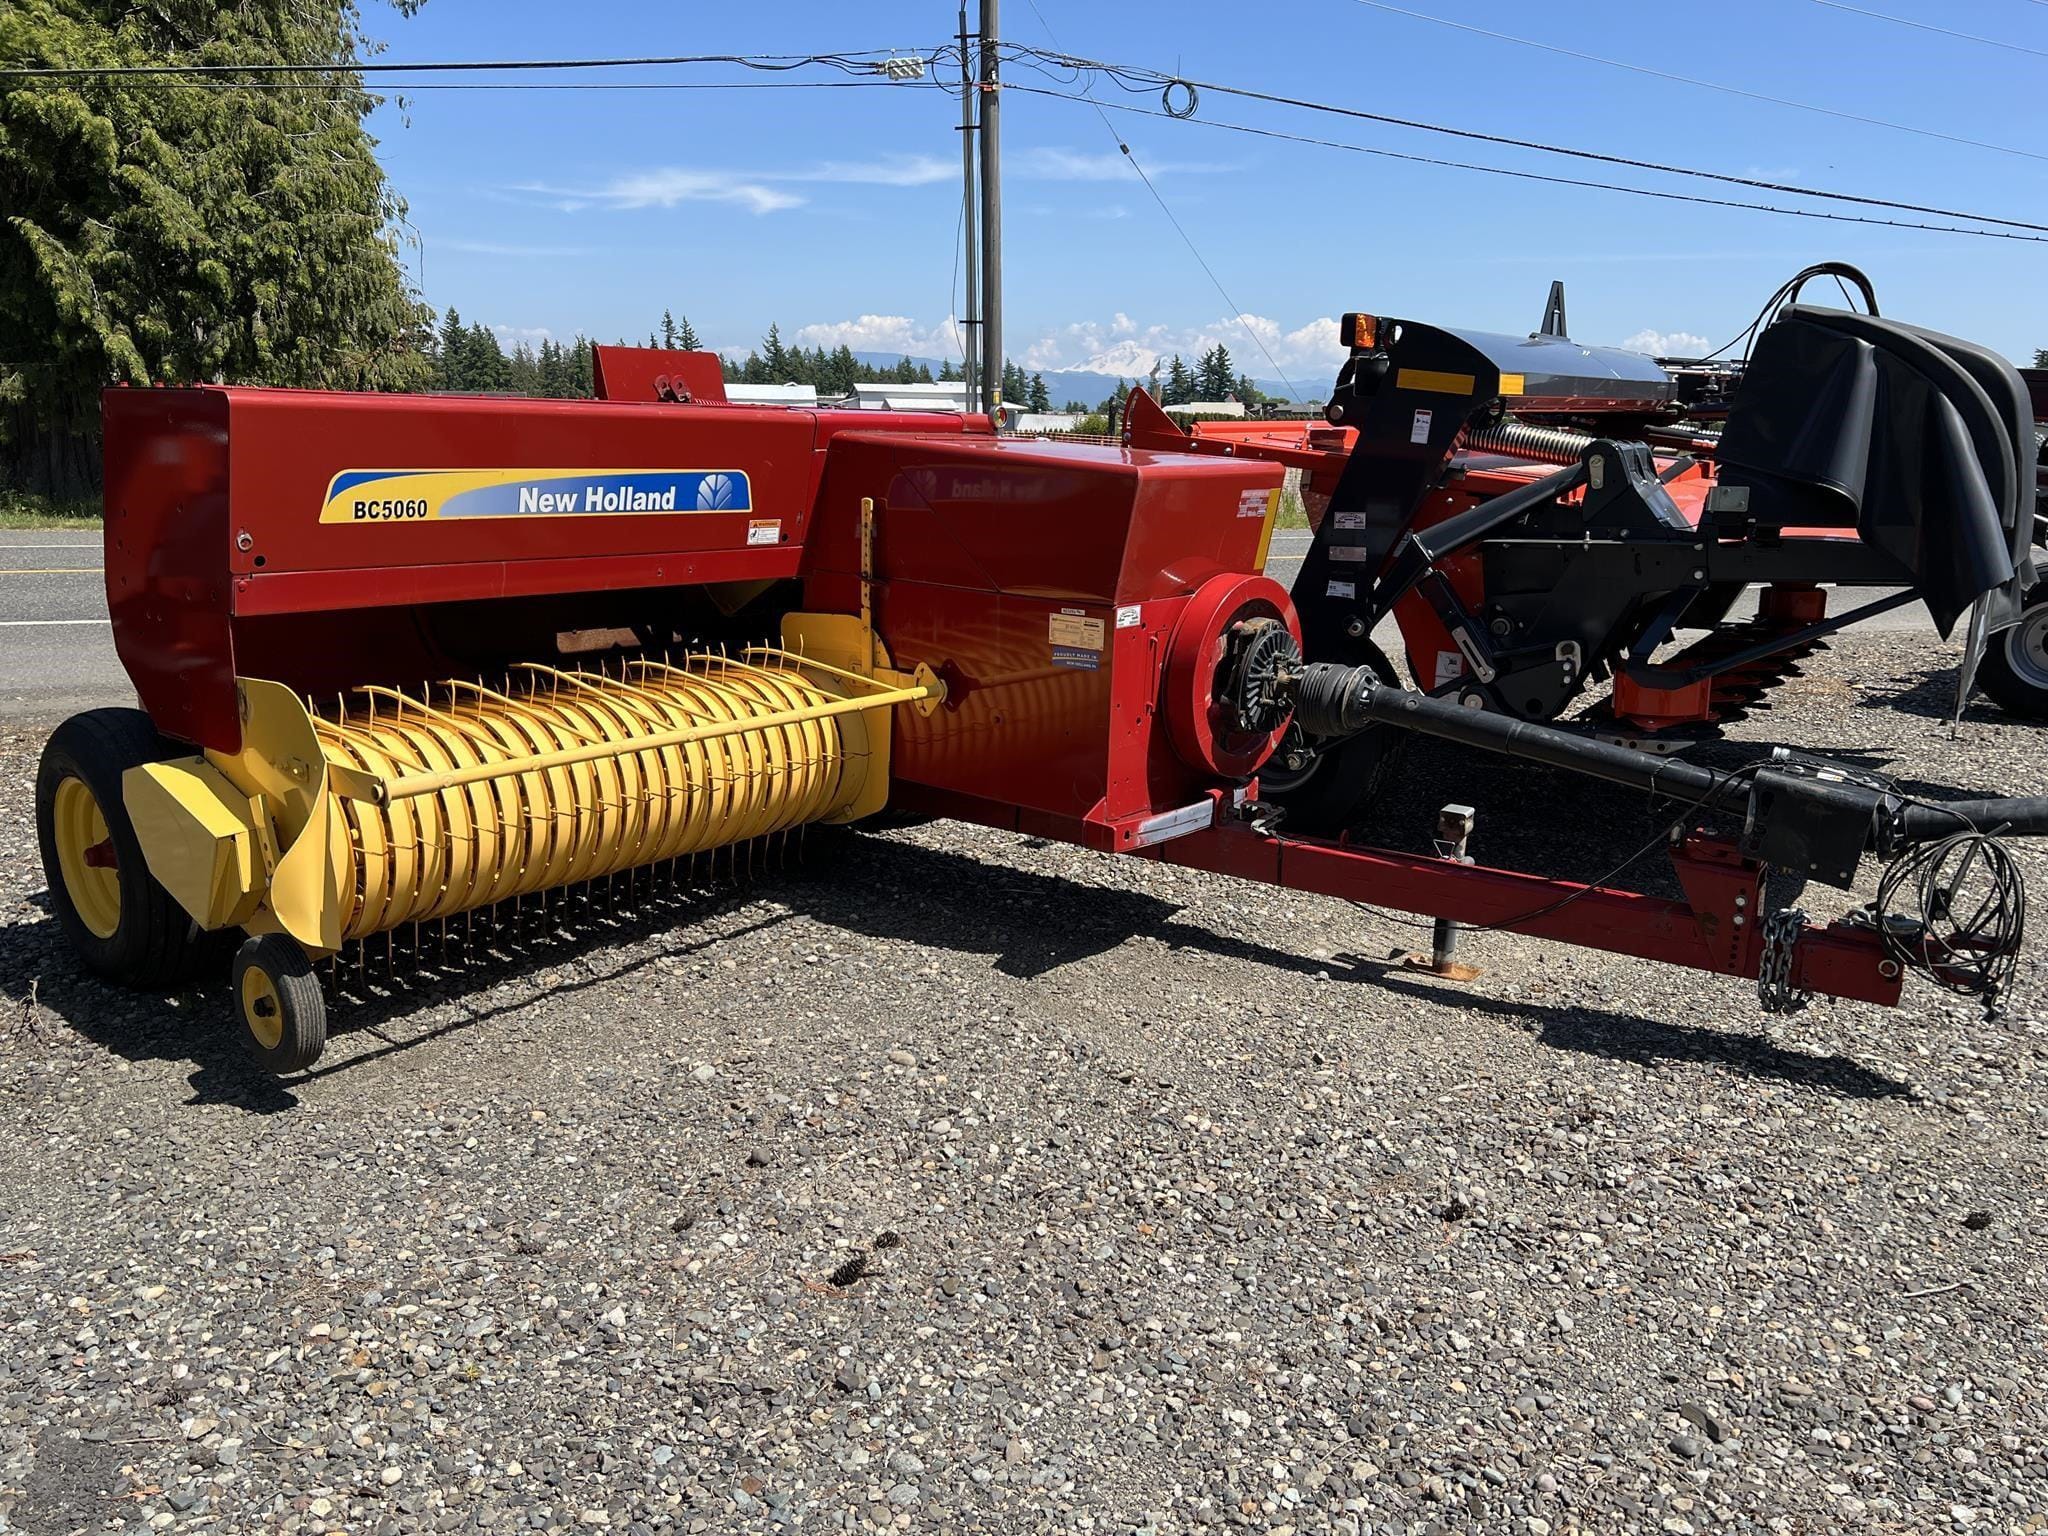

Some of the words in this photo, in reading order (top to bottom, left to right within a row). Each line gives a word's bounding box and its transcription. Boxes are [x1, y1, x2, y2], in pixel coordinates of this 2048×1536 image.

[354, 500, 428, 520] BC5060
[518, 487, 578, 513] New
[585, 486, 677, 512] Holland
